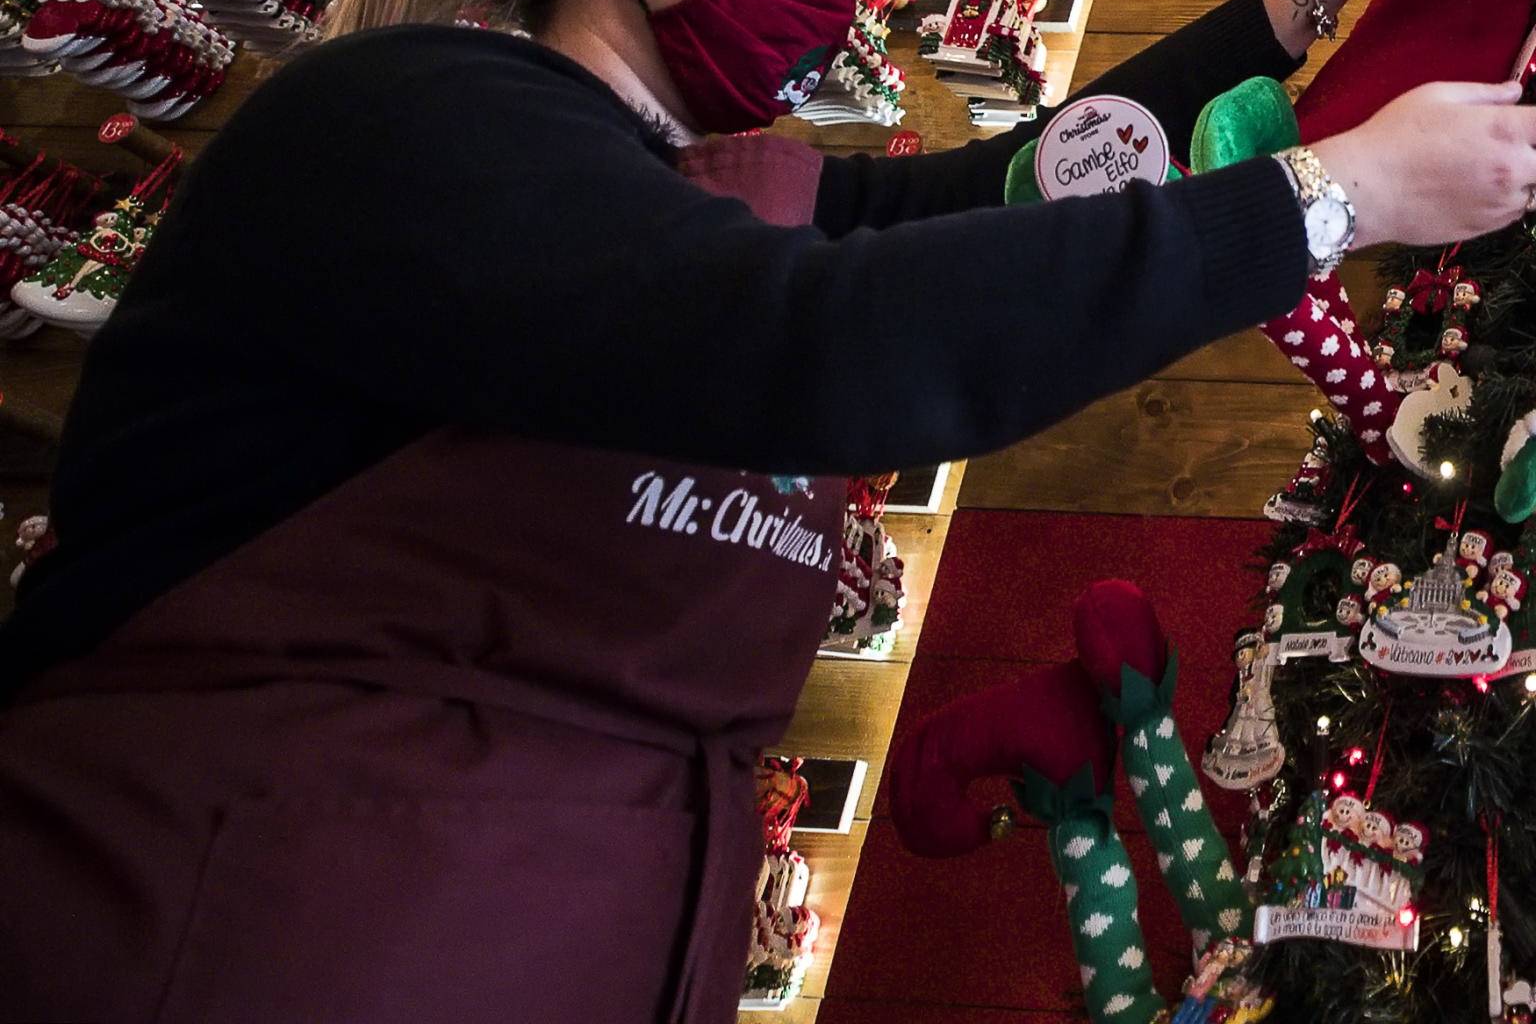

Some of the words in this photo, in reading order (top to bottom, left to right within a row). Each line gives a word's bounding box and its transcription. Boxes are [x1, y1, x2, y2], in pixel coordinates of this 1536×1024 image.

[1059, 112, 1112, 143] Christmas
[1055, 141, 1116, 186] Gambe
[1104, 151, 1139, 182] Elfo
